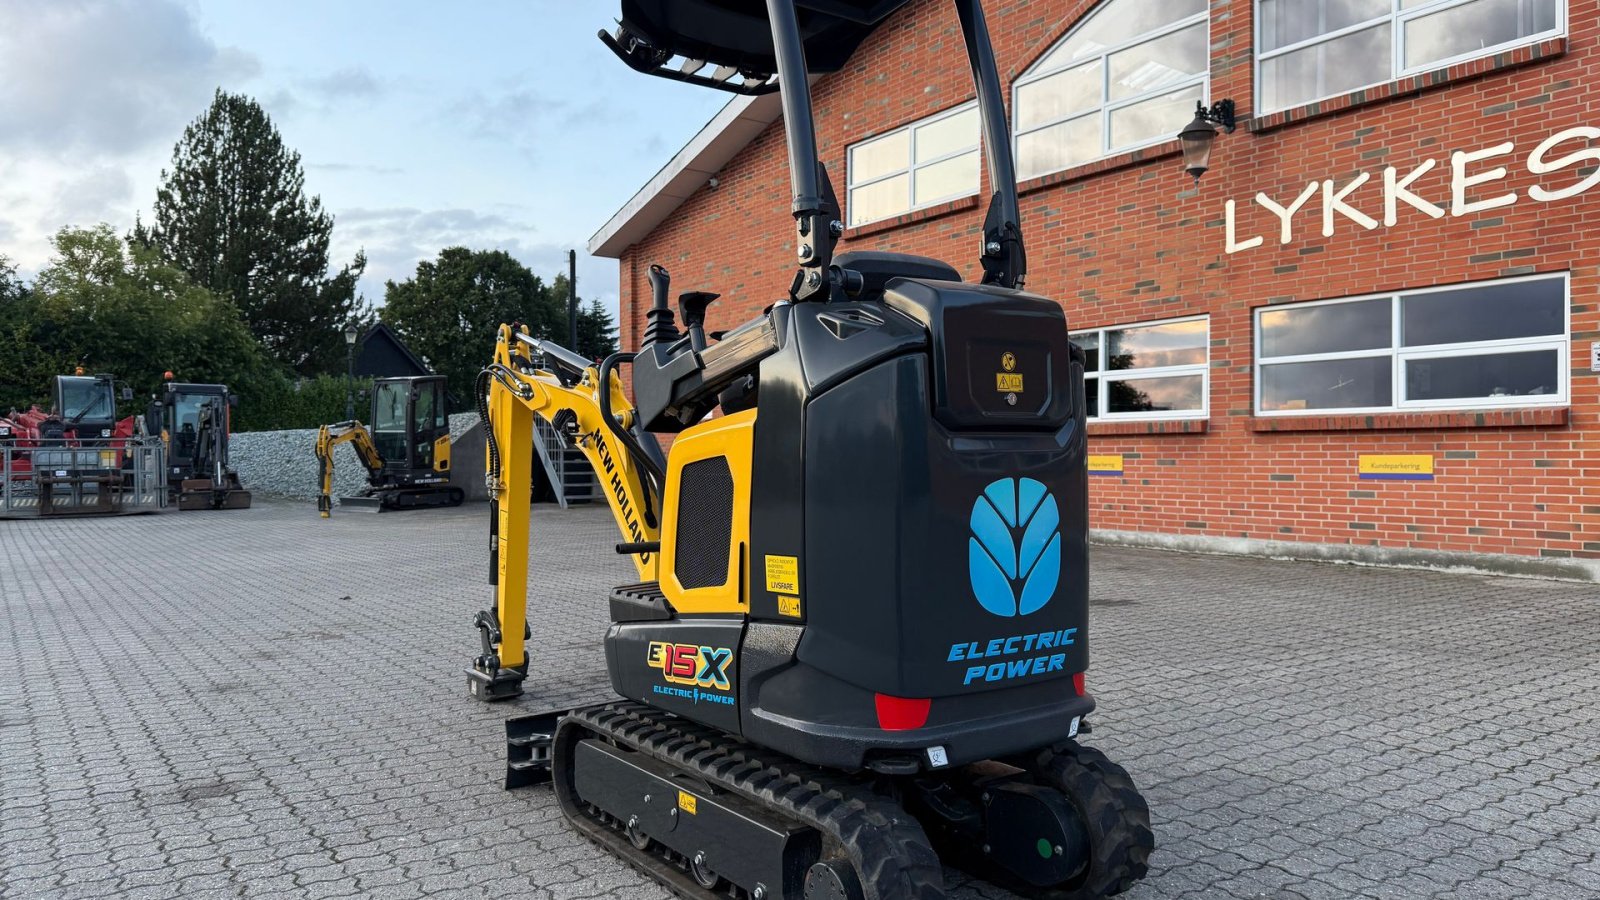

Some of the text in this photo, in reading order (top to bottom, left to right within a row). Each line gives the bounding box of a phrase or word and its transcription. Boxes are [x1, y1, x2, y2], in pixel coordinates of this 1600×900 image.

[1225, 126, 1600, 254] LYKKES
[592, 427, 650, 565] NEW HOLLAND
[648, 641, 733, 690] E15X
[947, 628, 1077, 662] ELECTRIC
[963, 653, 1066, 685] POWER
[653, 685, 735, 705] ELECTRIC POWER
